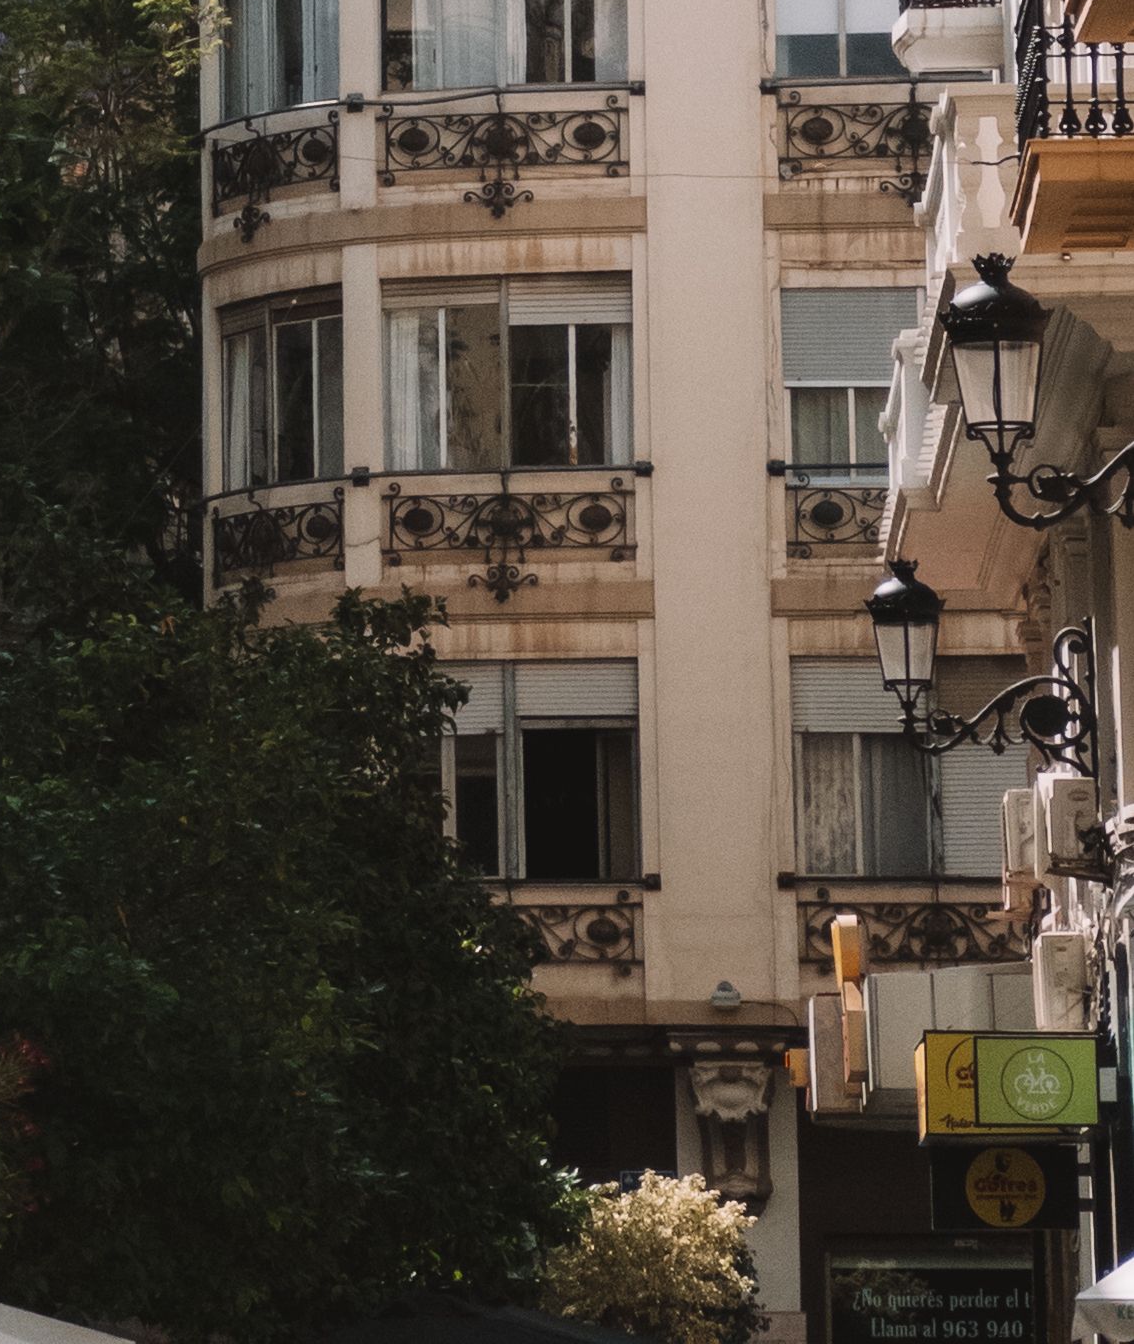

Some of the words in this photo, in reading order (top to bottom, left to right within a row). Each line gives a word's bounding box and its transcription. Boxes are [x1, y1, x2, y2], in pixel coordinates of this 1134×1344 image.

[1027, 1052, 1046, 1064] LA
[1017, 1096, 1058, 1115] VERDE
[852, 1288, 882, 1311] ¿No
[949, 1288, 1000, 1311] perder
[1006, 1288, 1019, 1308] el
[870, 1317, 917, 1338] Llama
[923, 1318, 937, 1338] al
[942, 1320, 979, 1338] 963
[986, 1320, 1024, 1338] 940
